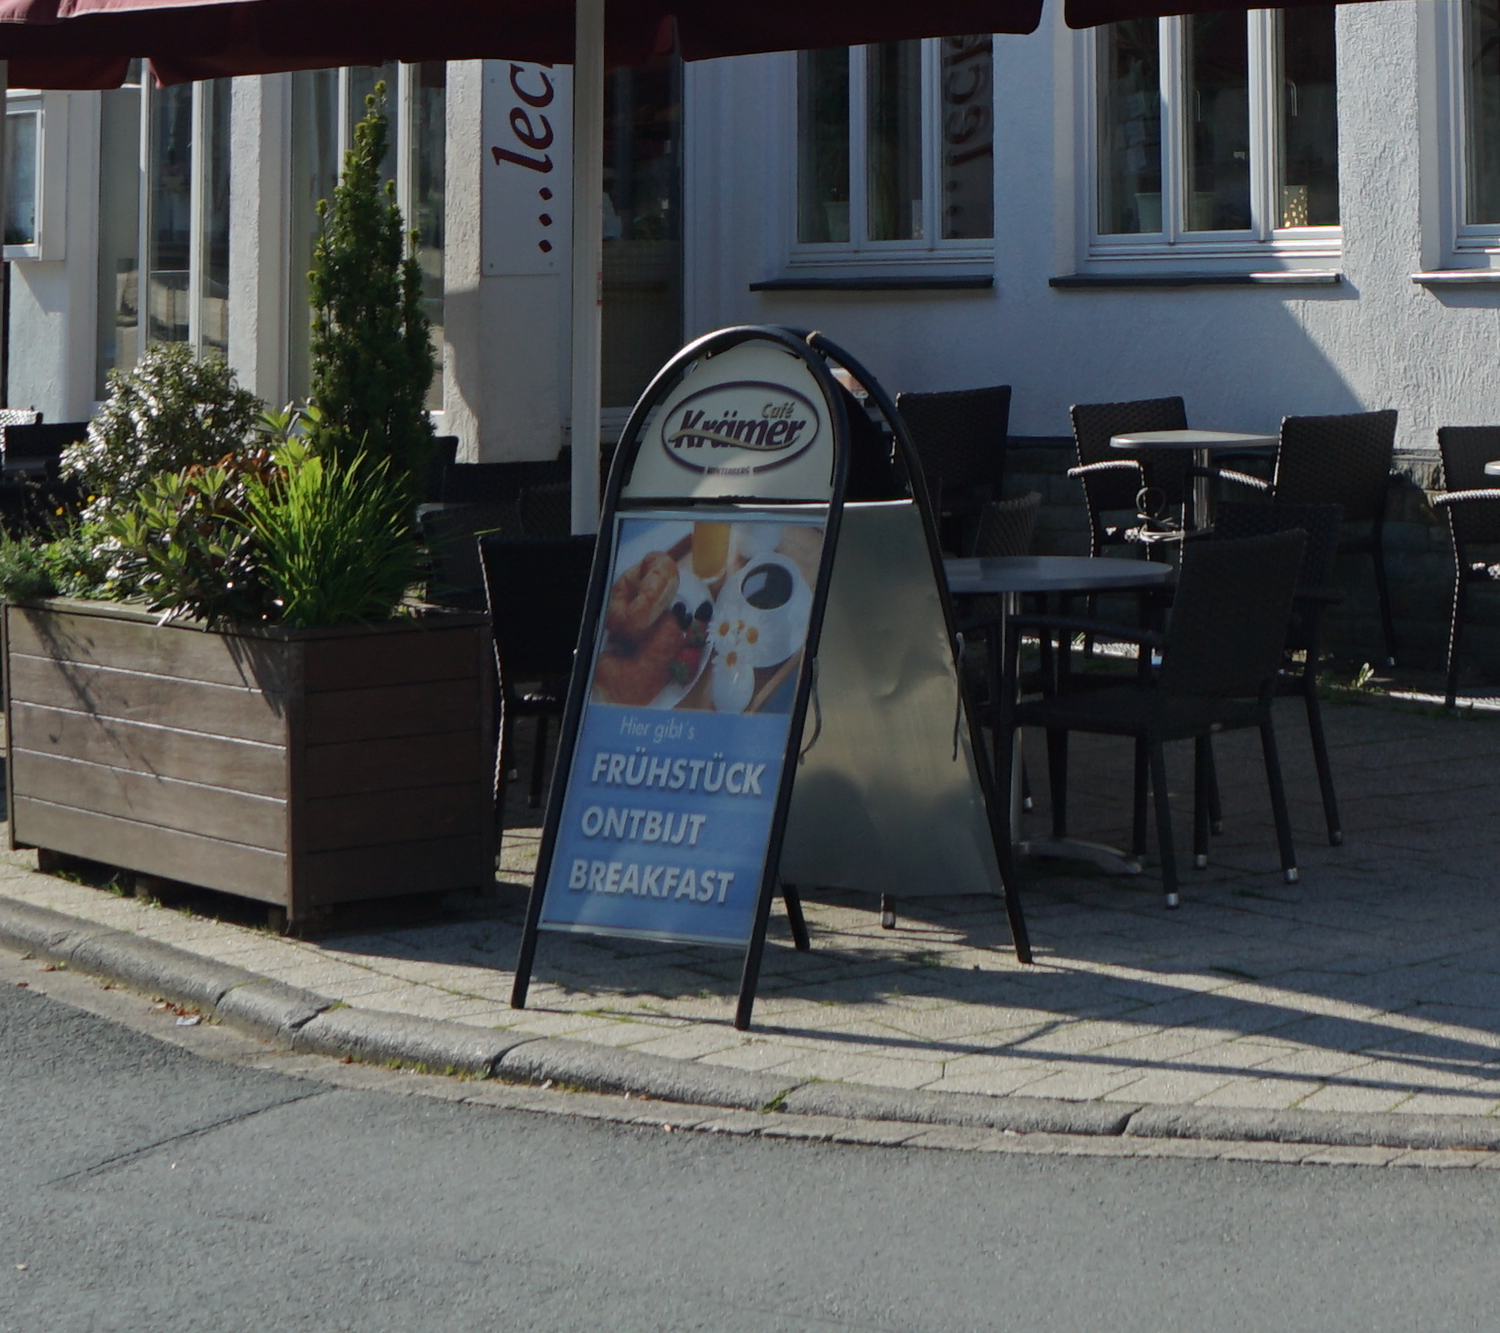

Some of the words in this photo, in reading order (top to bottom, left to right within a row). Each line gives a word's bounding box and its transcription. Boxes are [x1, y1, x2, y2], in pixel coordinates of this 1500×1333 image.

[491, 63, 554, 253] ...lec
[674, 410, 807, 450] Krämer
[762, 401, 796, 419] Café
[620, 716, 650, 736] Hier
[591, 746, 767, 796] FRÜHSTÜCK
[581, 805, 706, 846] ONTBIJT
[568, 858, 735, 904] BREAKFAST
